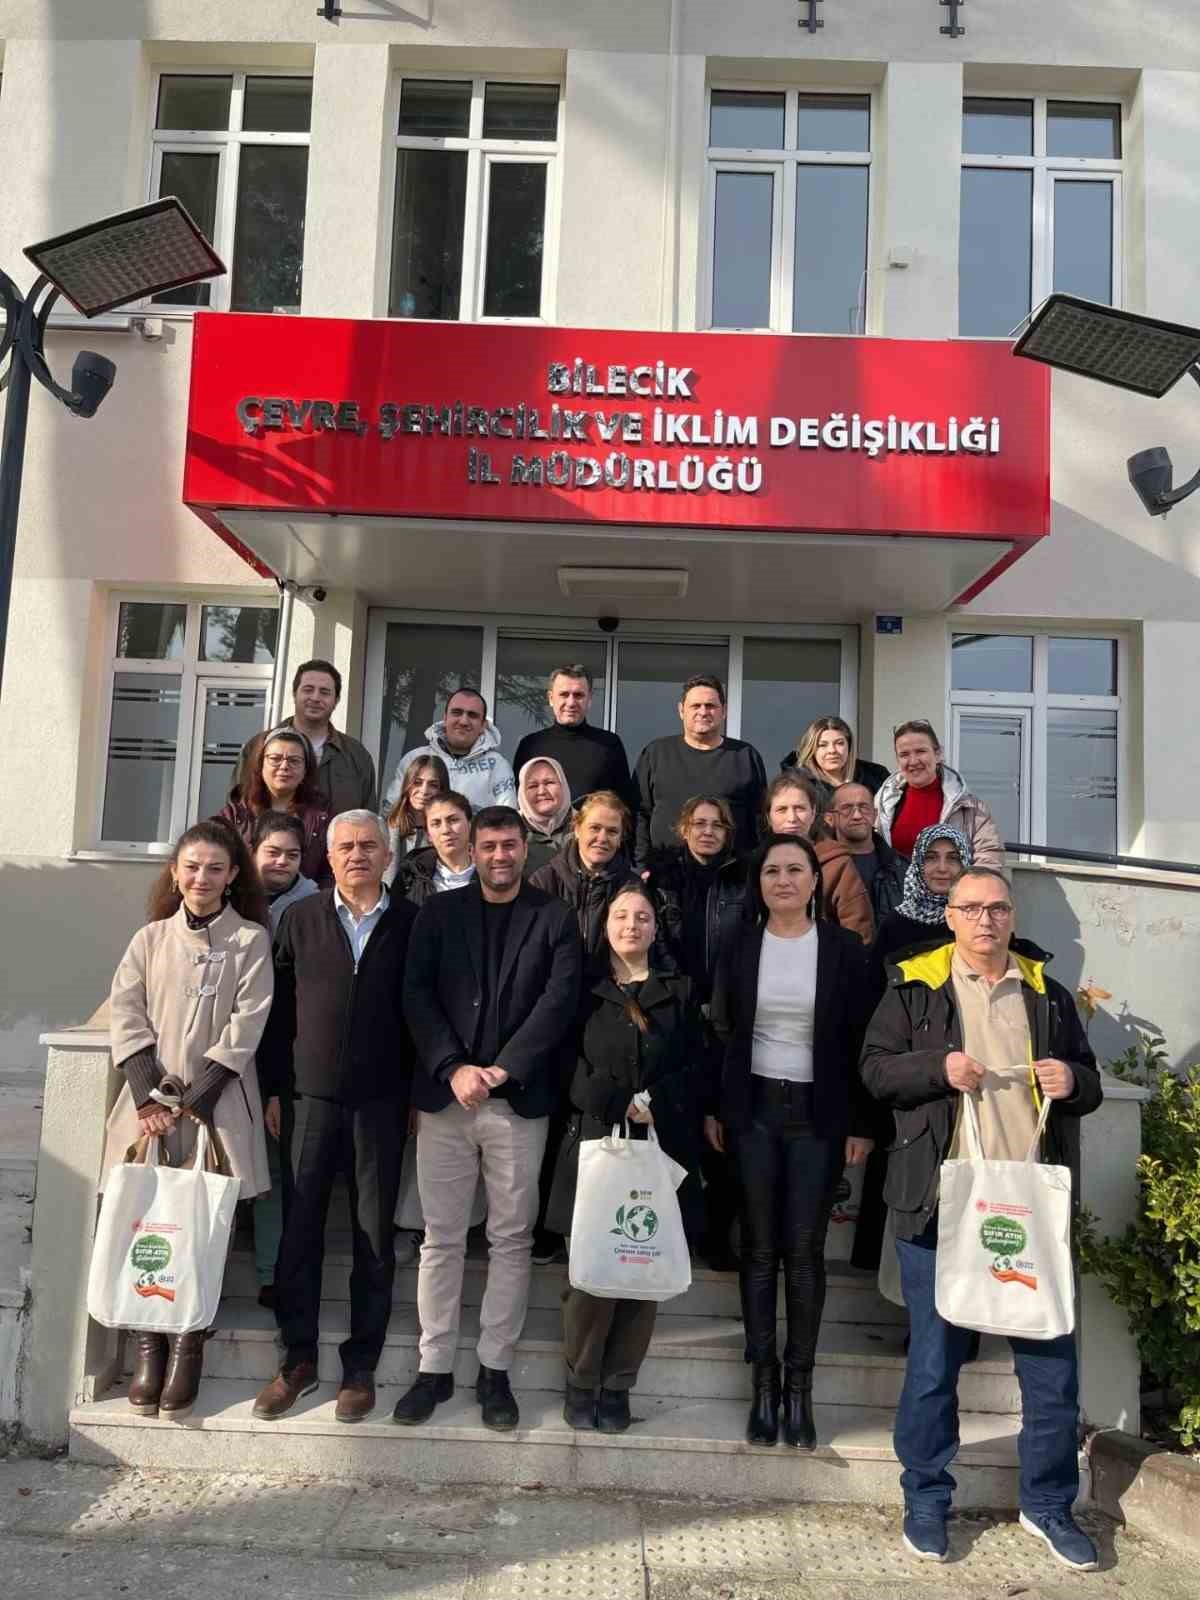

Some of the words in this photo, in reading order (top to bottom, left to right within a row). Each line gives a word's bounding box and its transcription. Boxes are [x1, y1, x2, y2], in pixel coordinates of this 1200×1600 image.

[547, 357, 694, 396] BİLECİK
[236, 396, 368, 437] ÇEVRE,
[378, 401, 588, 441] ŞEHİRCİLİK
[593, 410, 643, 442] VE
[653, 407, 758, 446] İKLİM
[769, 412, 1000, 457] DEĞİŞİKLİĞİ
[467, 448, 500, 484] İL
[511, 450, 762, 492] MÜDÜRLÜĞÜ
